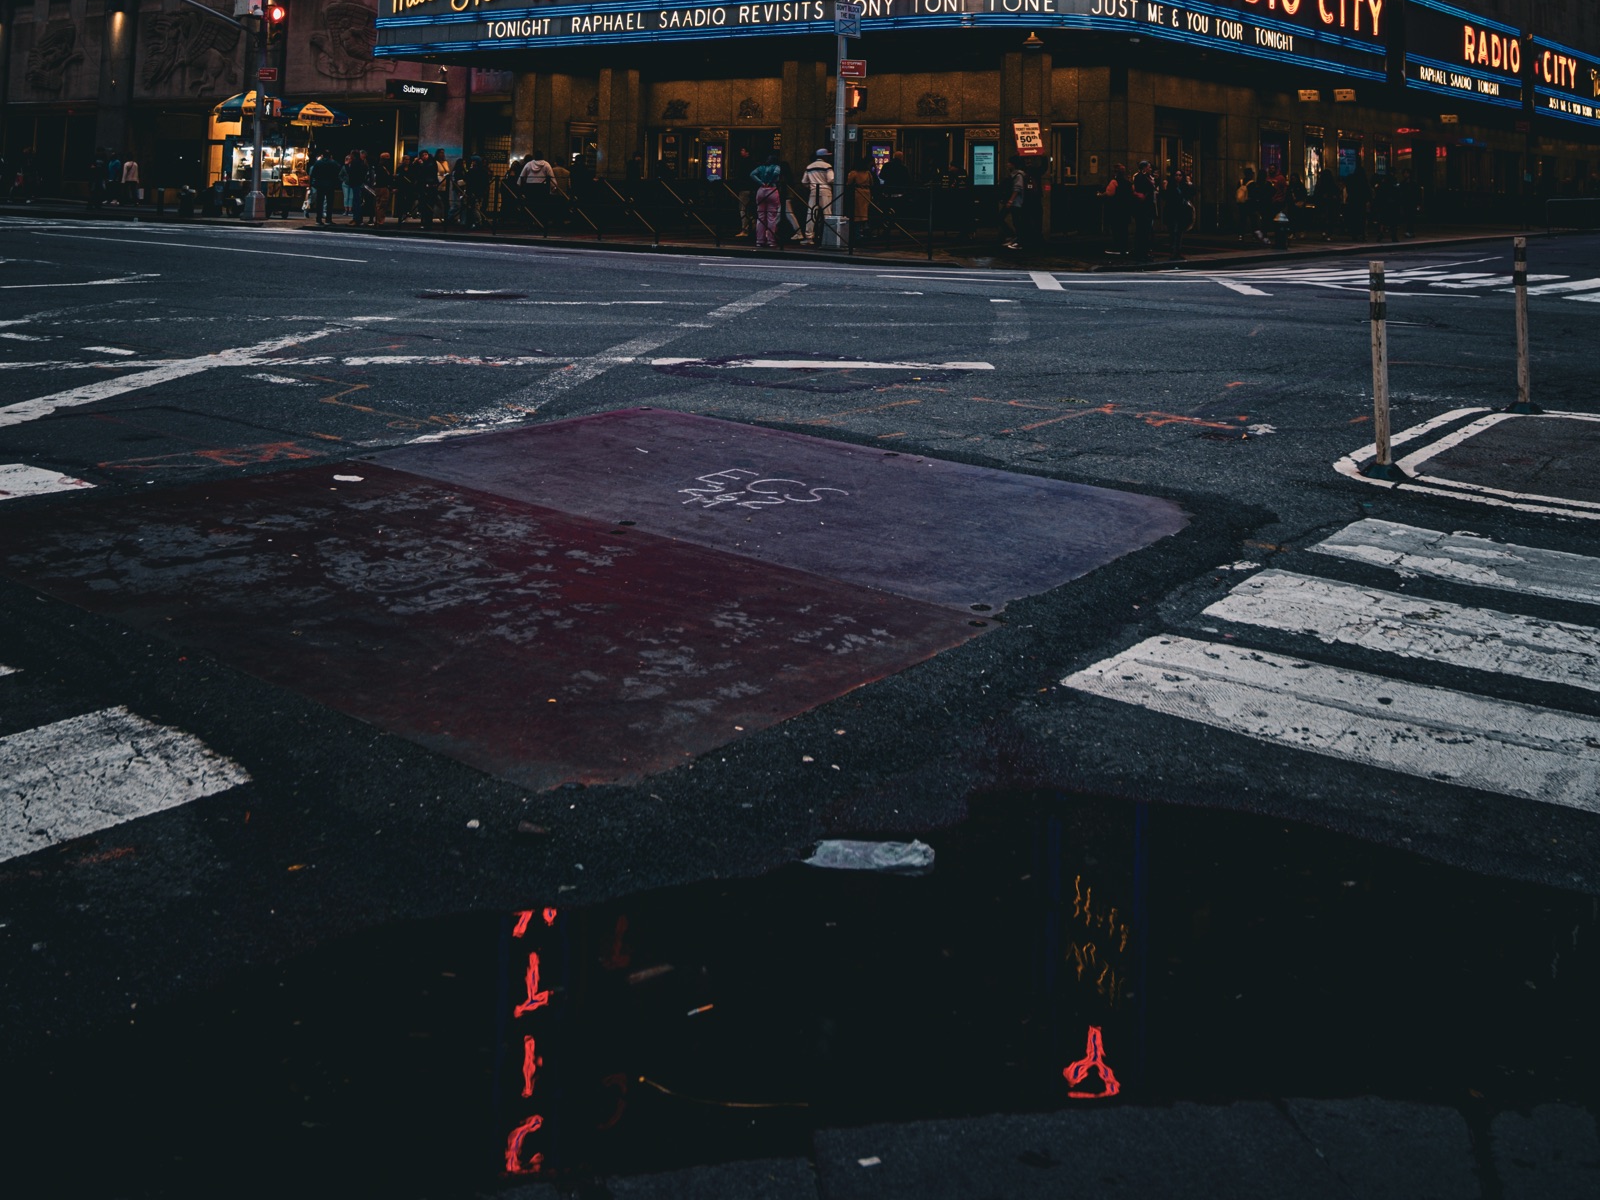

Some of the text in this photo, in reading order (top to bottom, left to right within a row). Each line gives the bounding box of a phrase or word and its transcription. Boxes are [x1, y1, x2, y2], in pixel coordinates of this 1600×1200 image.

[487, 18, 550, 38] TONIGHT
[571, 12, 645, 33] RAPHAEL
[659, 7, 726, 28] SAADIQ
[739, 1, 825, 24] REVISITS
[1147, 3, 1164, 25] ME
[1172, 8, 1179, 27] &
[1186, 11, 1209, 34] YOU
[1215, 18, 1243, 41] TOUR
[1254, 27, 1294, 51] TONIGHT
[1464, 25, 1520, 73] RADIO
[1543, 51, 1577, 89] CITY
[402, 84, 428, 96] Subway
[1420, 66, 1447, 86] RAPHAEL
[1477, 80, 1499, 96] TONIGHT
[1020, 135, 1038, 143] 50th
